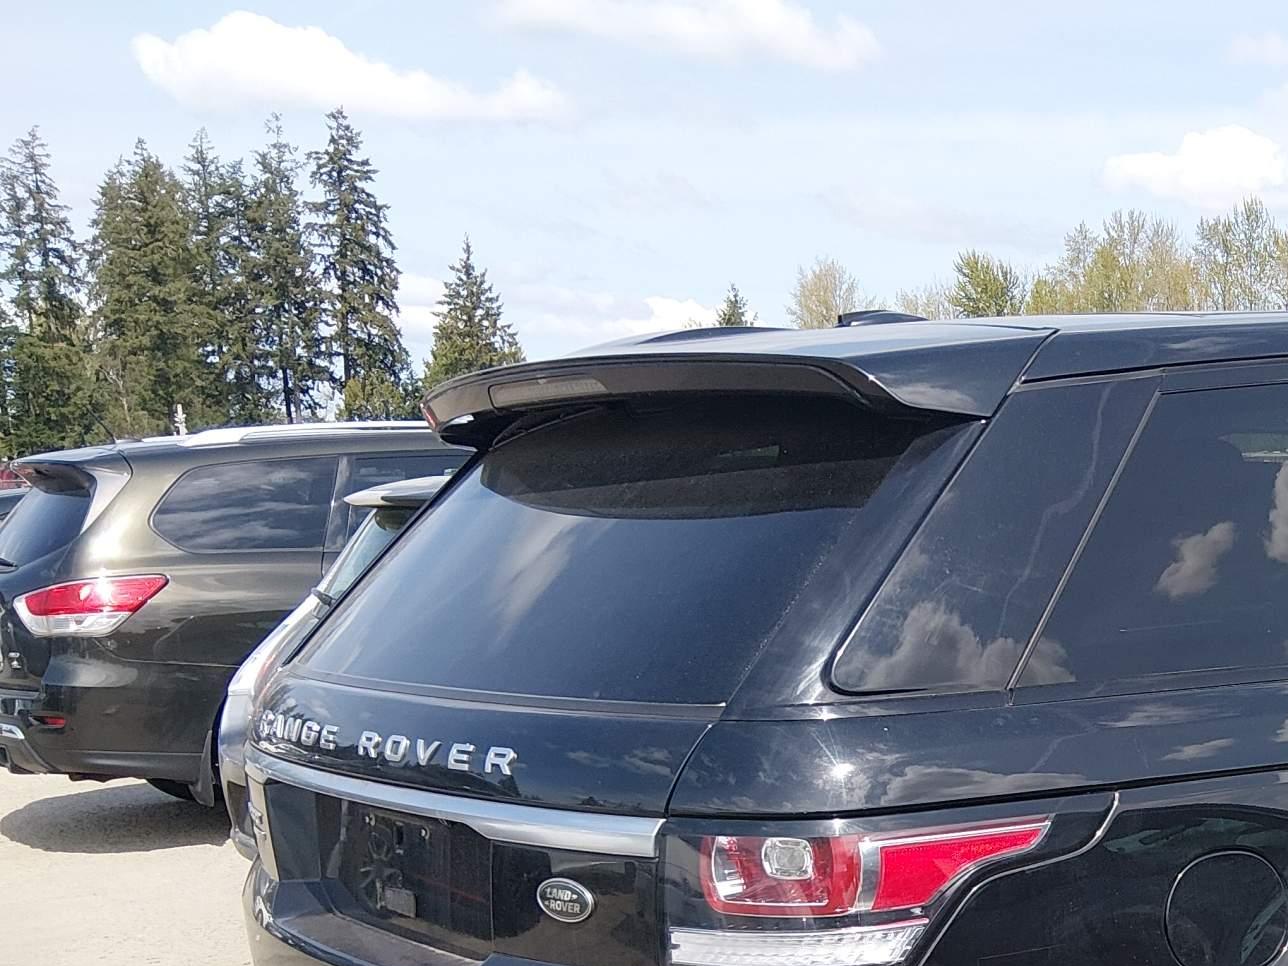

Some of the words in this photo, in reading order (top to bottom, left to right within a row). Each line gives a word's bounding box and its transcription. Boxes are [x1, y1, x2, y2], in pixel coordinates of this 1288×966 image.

[357, 730, 517, 776] ROVER
[545, 887, 572, 901] LAND
[549, 899, 581, 914] ROVER
